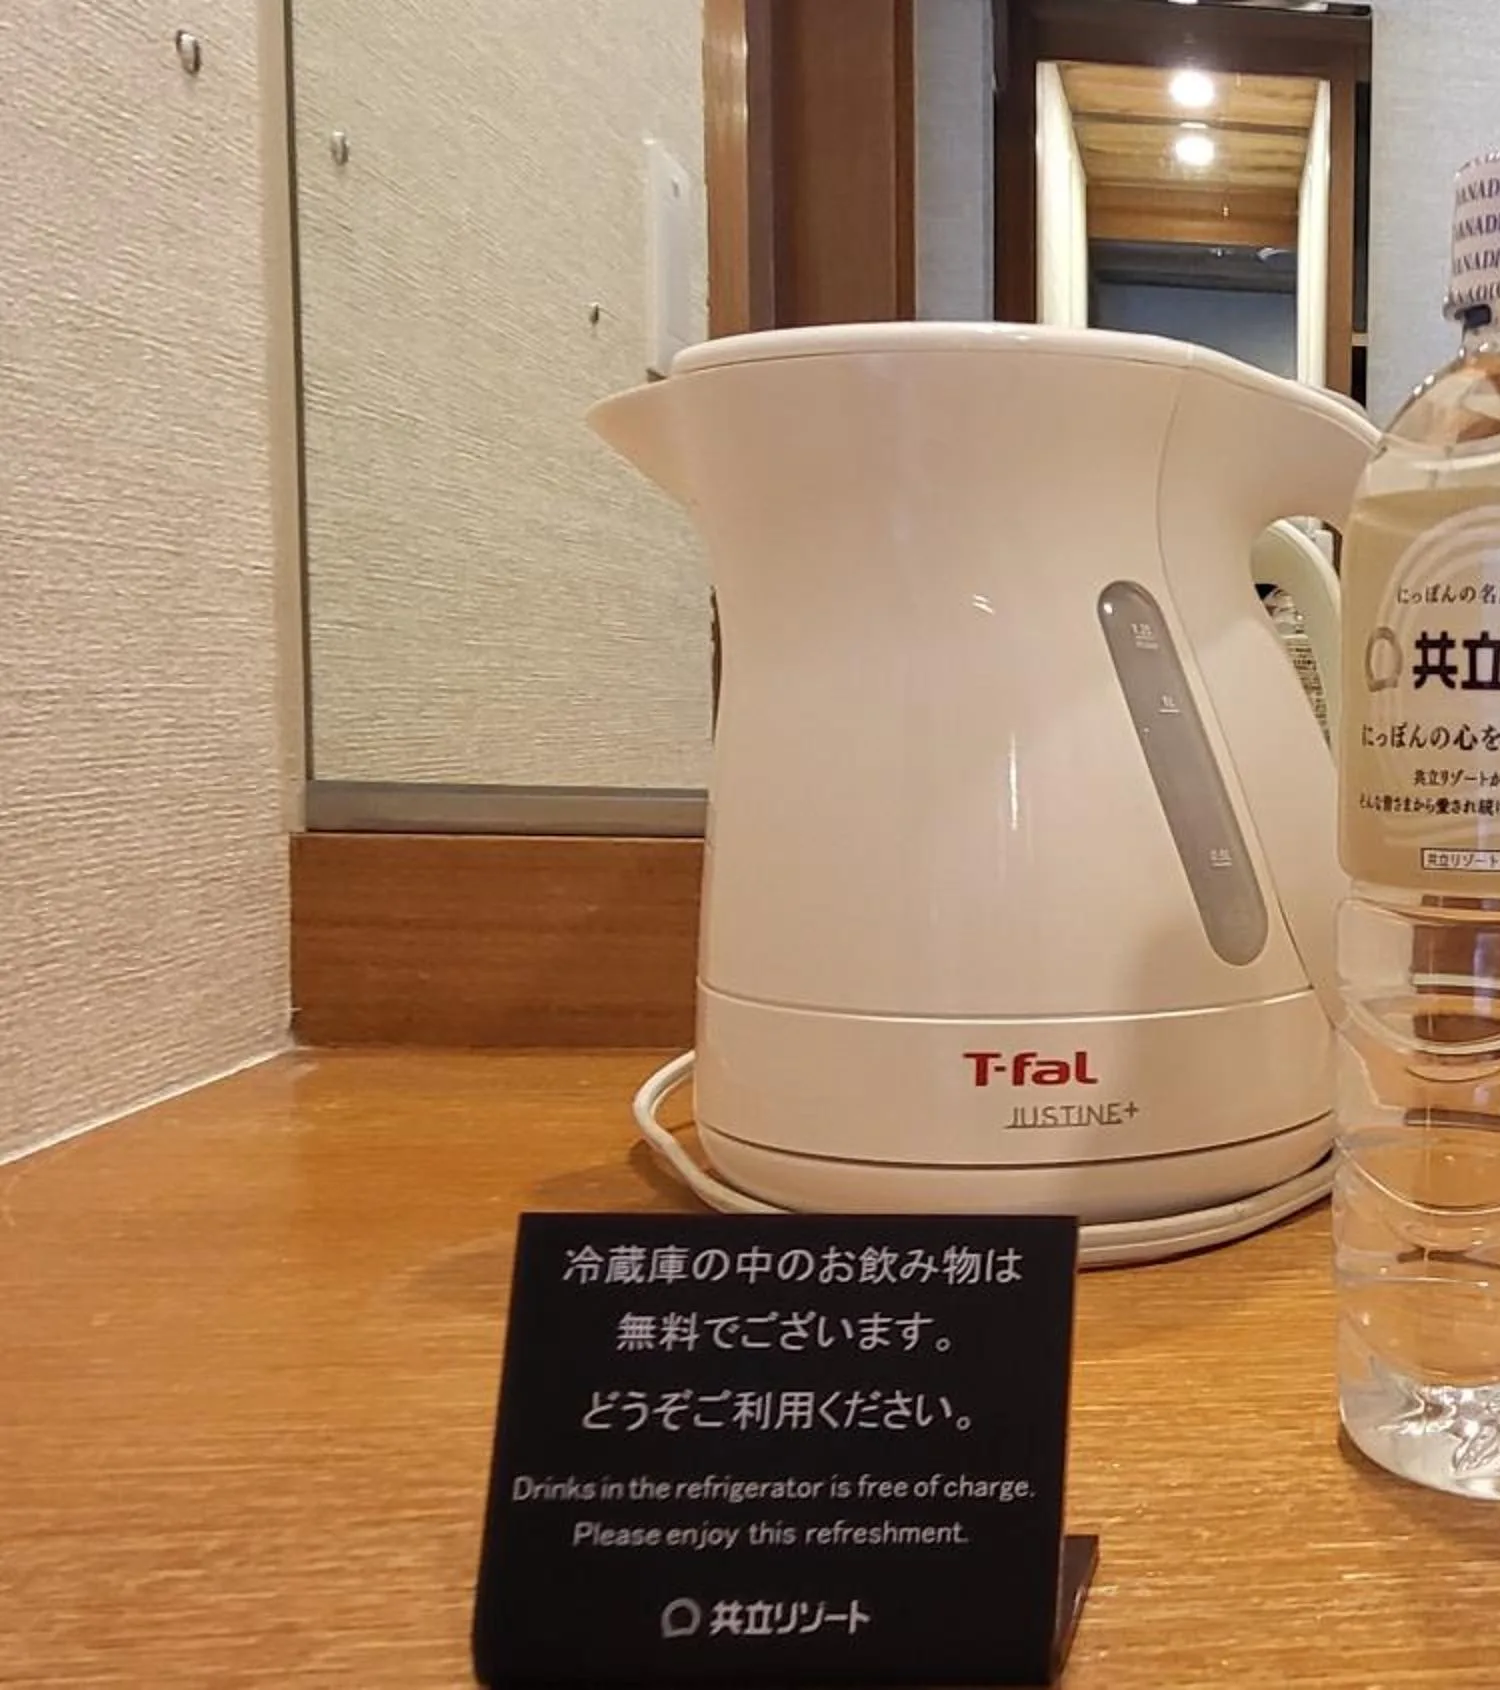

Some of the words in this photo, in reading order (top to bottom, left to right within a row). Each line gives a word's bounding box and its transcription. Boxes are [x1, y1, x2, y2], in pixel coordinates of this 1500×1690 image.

[563, 1245, 1022, 1284] 冷蔵庫の中のお飲み物は
[617, 1312, 950, 1351] 無料でございます。
[583, 1390, 970, 1430] どうぞご利用ください。
[513, 1476, 595, 1500] Drinks
[602, 1476, 623, 1498] in
[629, 1477, 670, 1499] the
[676, 1475, 824, 1502] refrigerator
[831, 1475, 851, 1497] is
[858, 1474, 908, 1497] free
[914, 1474, 941, 1497] of
[945, 1475, 1034, 1501] charge.
[574, 1522, 661, 1545] Please
[667, 1522, 739, 1549] enjoy
[749, 1521, 796, 1544] this
[806, 1520, 967, 1544] refreshment.
[711, 1600, 869, 1634] 共立リゾート
